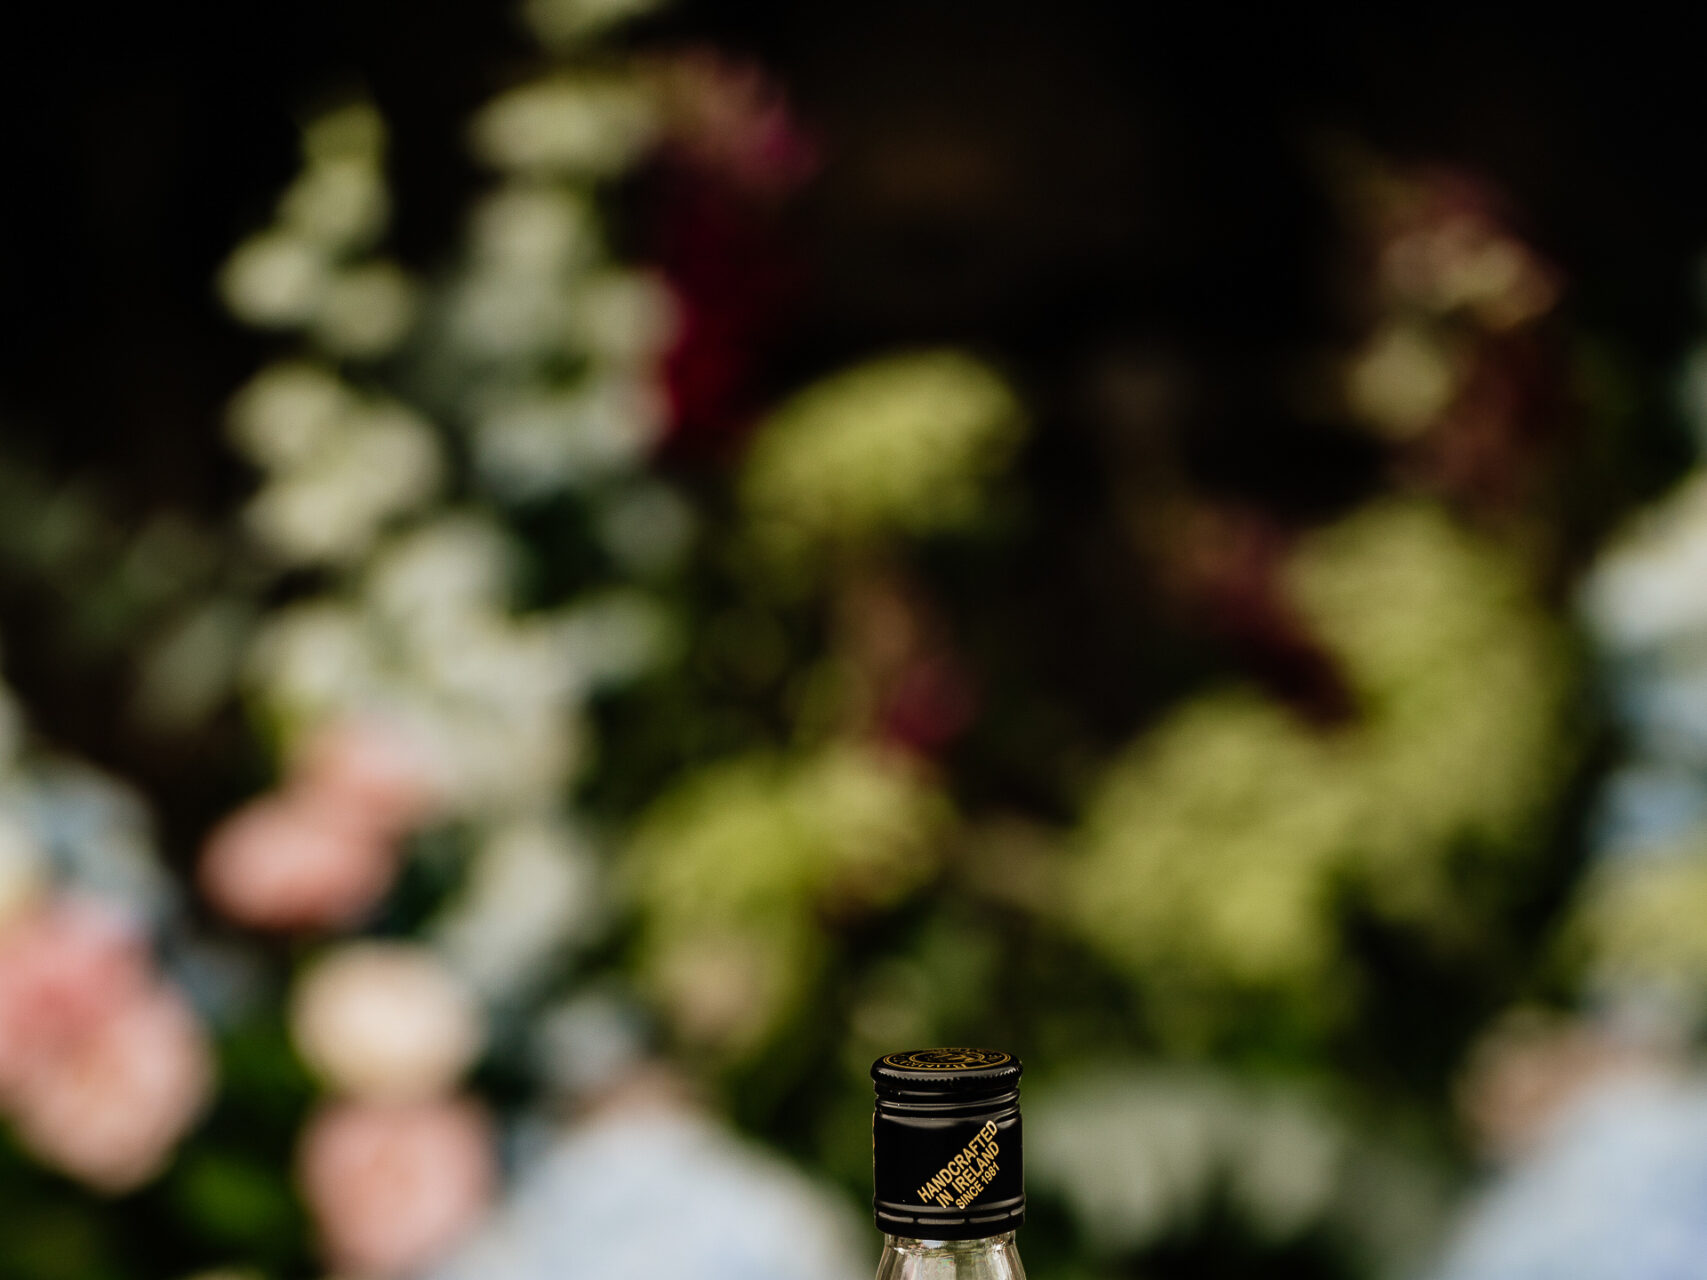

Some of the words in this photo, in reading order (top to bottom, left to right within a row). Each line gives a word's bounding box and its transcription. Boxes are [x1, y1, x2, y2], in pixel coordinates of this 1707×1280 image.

[917, 1120, 998, 1203] HANDCRAFTED
[936, 1189, 954, 1209] IN
[952, 1141, 999, 1194] IRELAND
[955, 1180, 984, 1210] SINCE
[981, 1161, 1000, 1184] 1981
